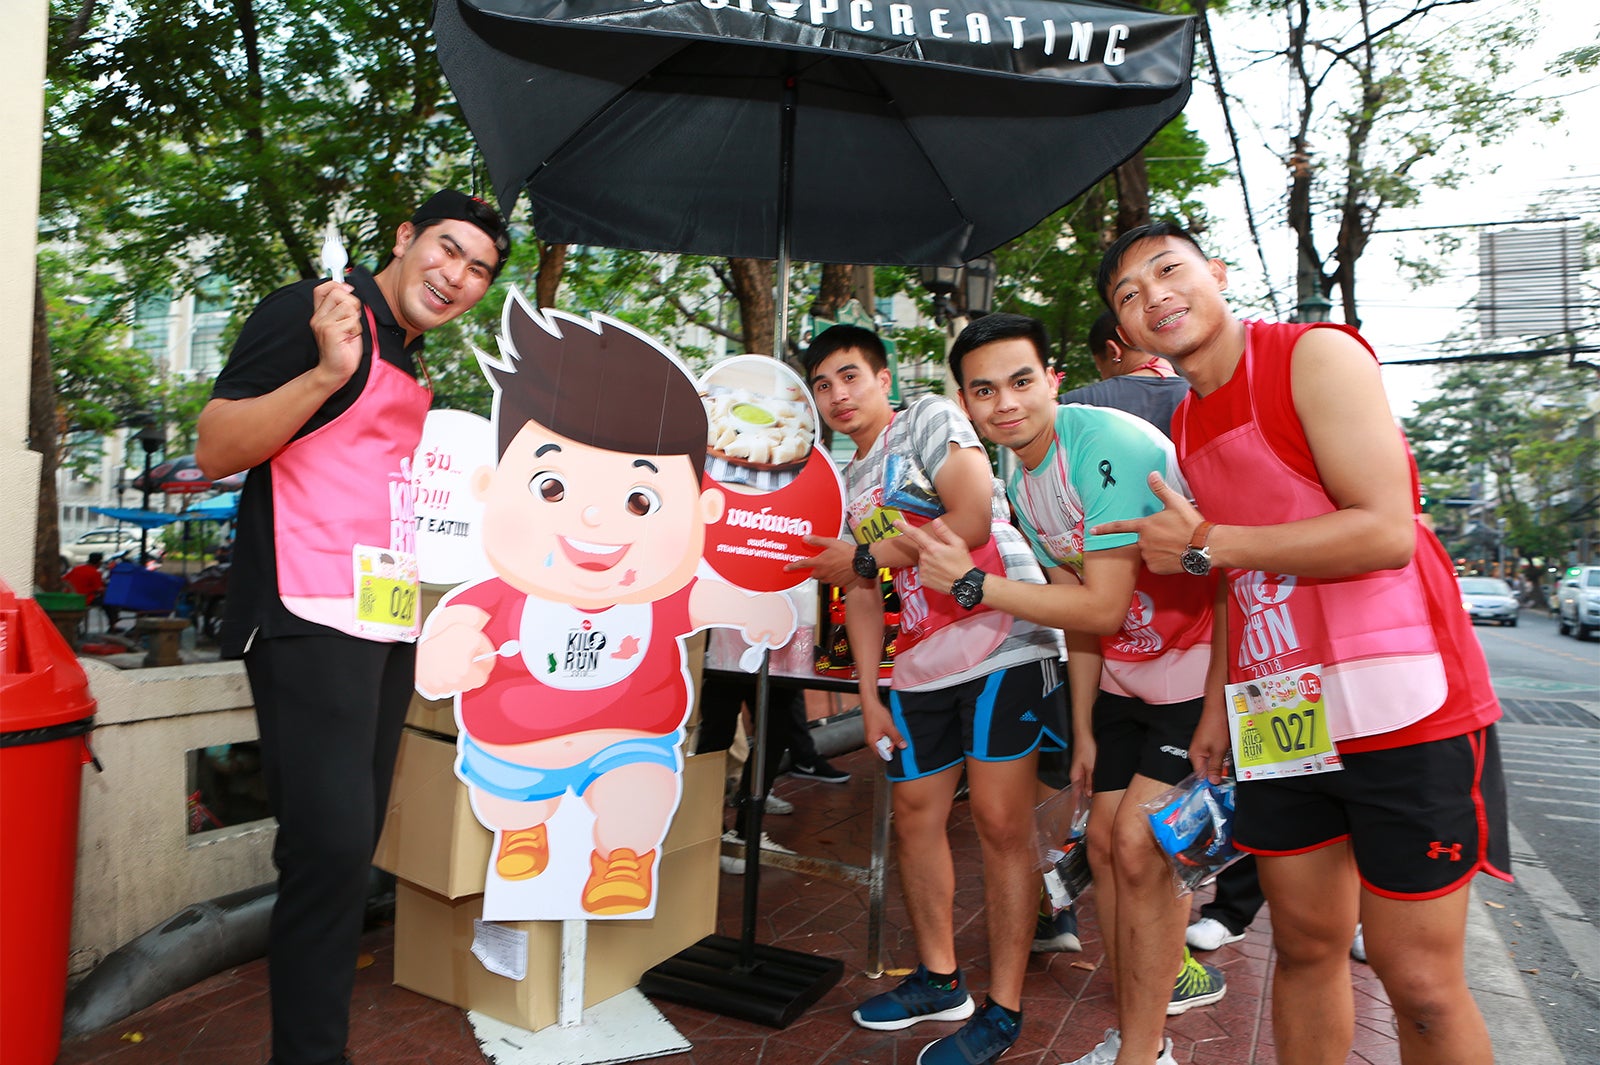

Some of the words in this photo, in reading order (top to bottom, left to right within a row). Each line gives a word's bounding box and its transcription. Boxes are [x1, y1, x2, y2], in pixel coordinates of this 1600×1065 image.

[726, 507, 812, 536] มนต์นมสด
[862, 511, 894, 543] 044
[564, 651, 599, 670] RUN
[1252, 658, 1282, 679] 2018
[1271, 709, 1314, 752] 027
[1243, 744, 1263, 758] RUN
